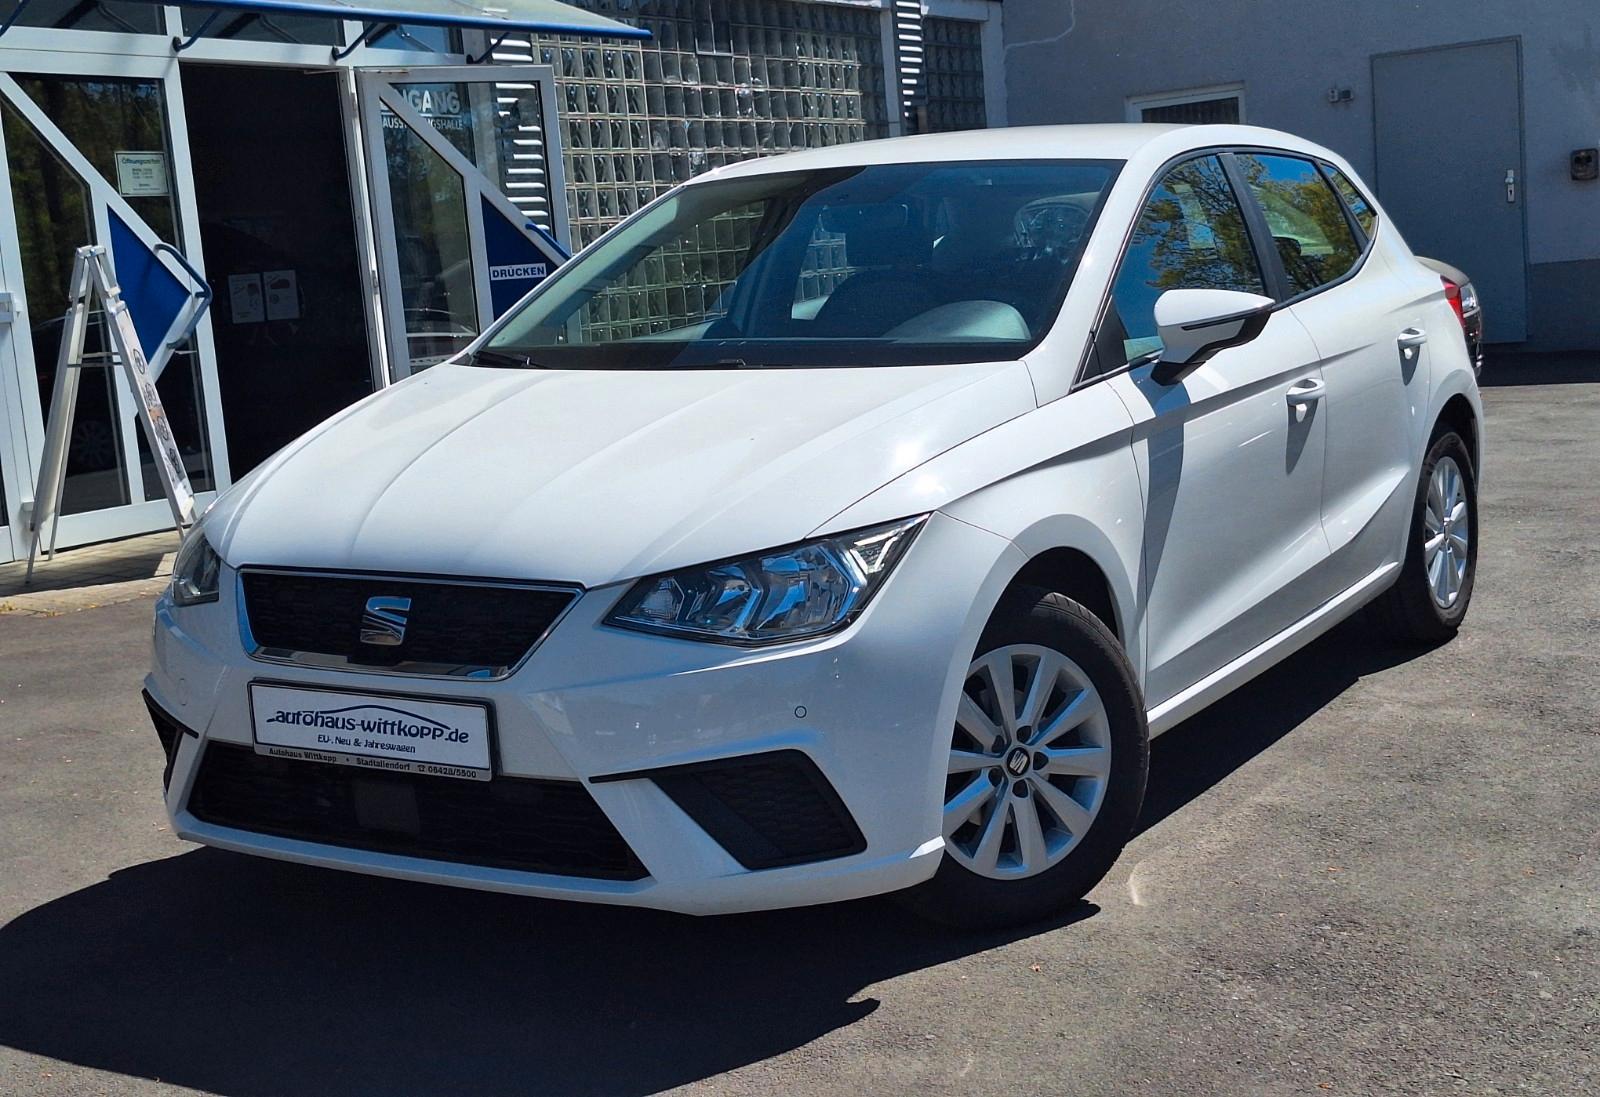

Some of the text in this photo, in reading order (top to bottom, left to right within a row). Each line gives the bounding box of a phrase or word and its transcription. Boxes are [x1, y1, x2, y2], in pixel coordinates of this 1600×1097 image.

[492, 265, 545, 278] DRÜCKEN
[275, 710, 469, 744] autohaus-wittkopp.de
[334, 736, 351, 747] Neu
[364, 739, 416, 753] Jahreswagen
[268, 747, 303, 759] Autohaus
[303, 751, 337, 763] Wittkopp
[356, 757, 410, 771] Stadtallendorf
